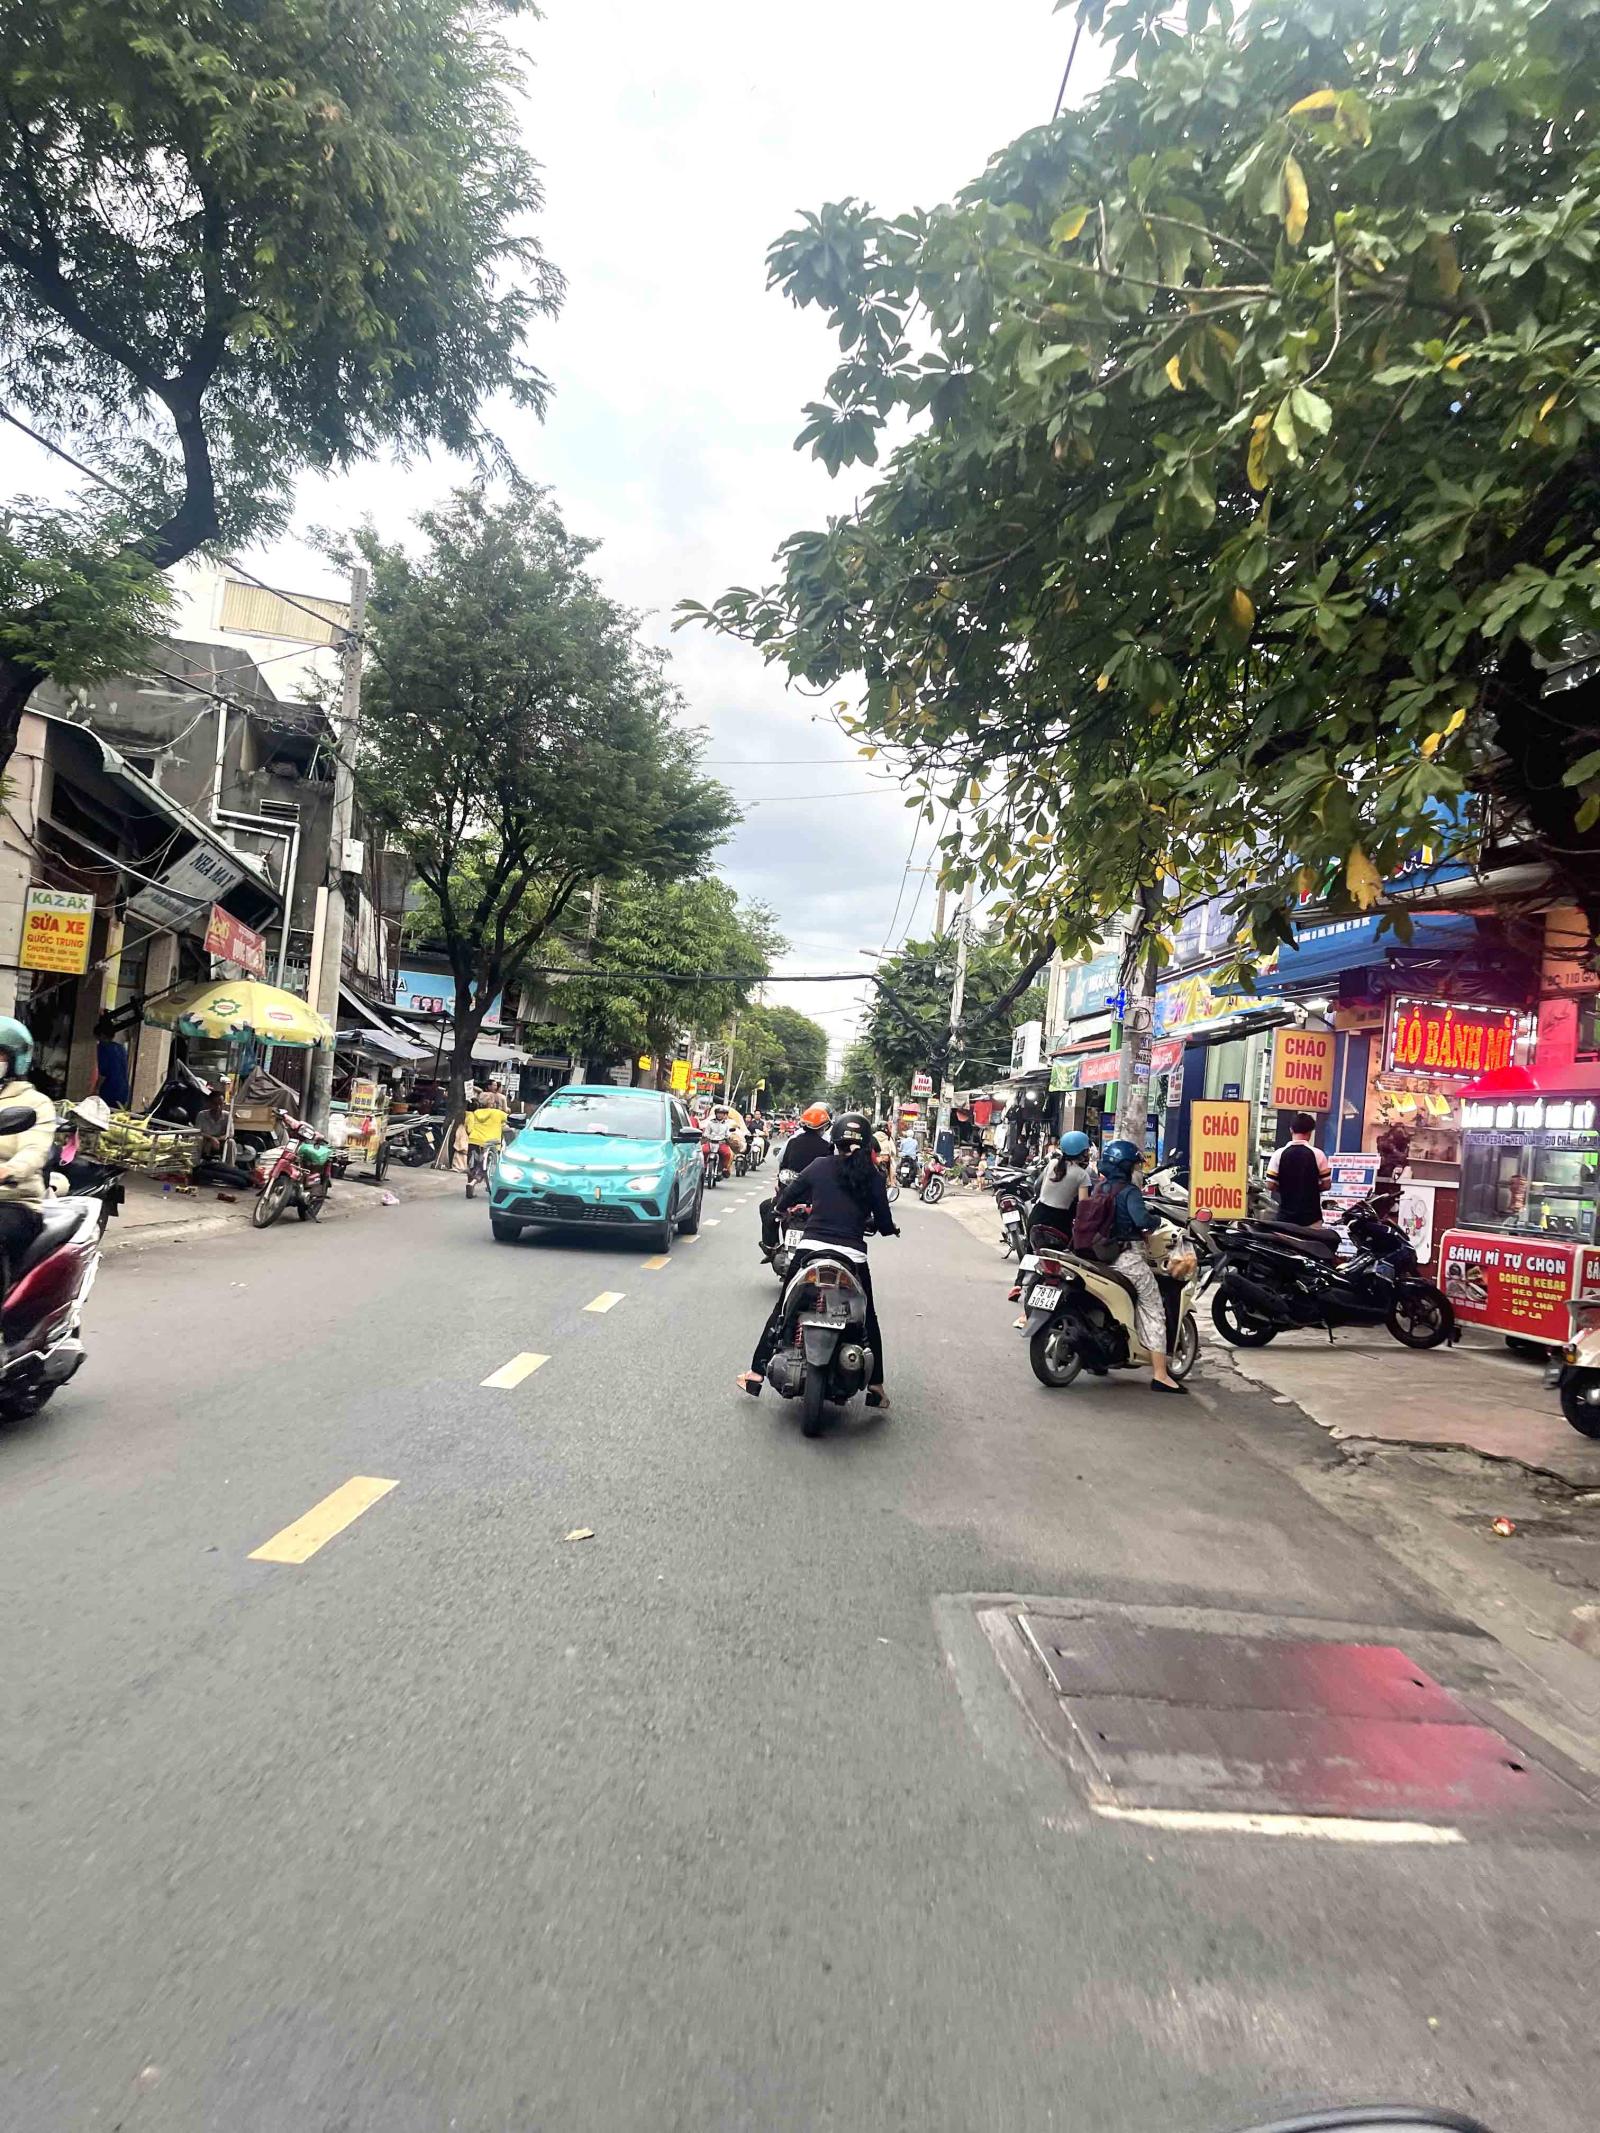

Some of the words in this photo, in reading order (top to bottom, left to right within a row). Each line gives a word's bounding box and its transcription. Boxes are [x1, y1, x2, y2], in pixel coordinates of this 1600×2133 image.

[32, 892, 89, 910] KAZAX
[30, 913, 60, 932] SỬA
[65, 919, 85, 935] XE
[1423, 1009, 1483, 1071] BÁNH
[1275, 1085, 1328, 1108] DƯỠNG
[1202, 1112, 1240, 1136] CHÁO
[1203, 1151, 1237, 1172] DINH
[1195, 1183, 1242, 1209] DƯỠNG
[1449, 1244, 1482, 1262] BÁNH
[1485, 1248, 1500, 1266] MÌ
[1503, 1252, 1523, 1272] TỰ
[1526, 1256, 1566, 1276] CHỌN
